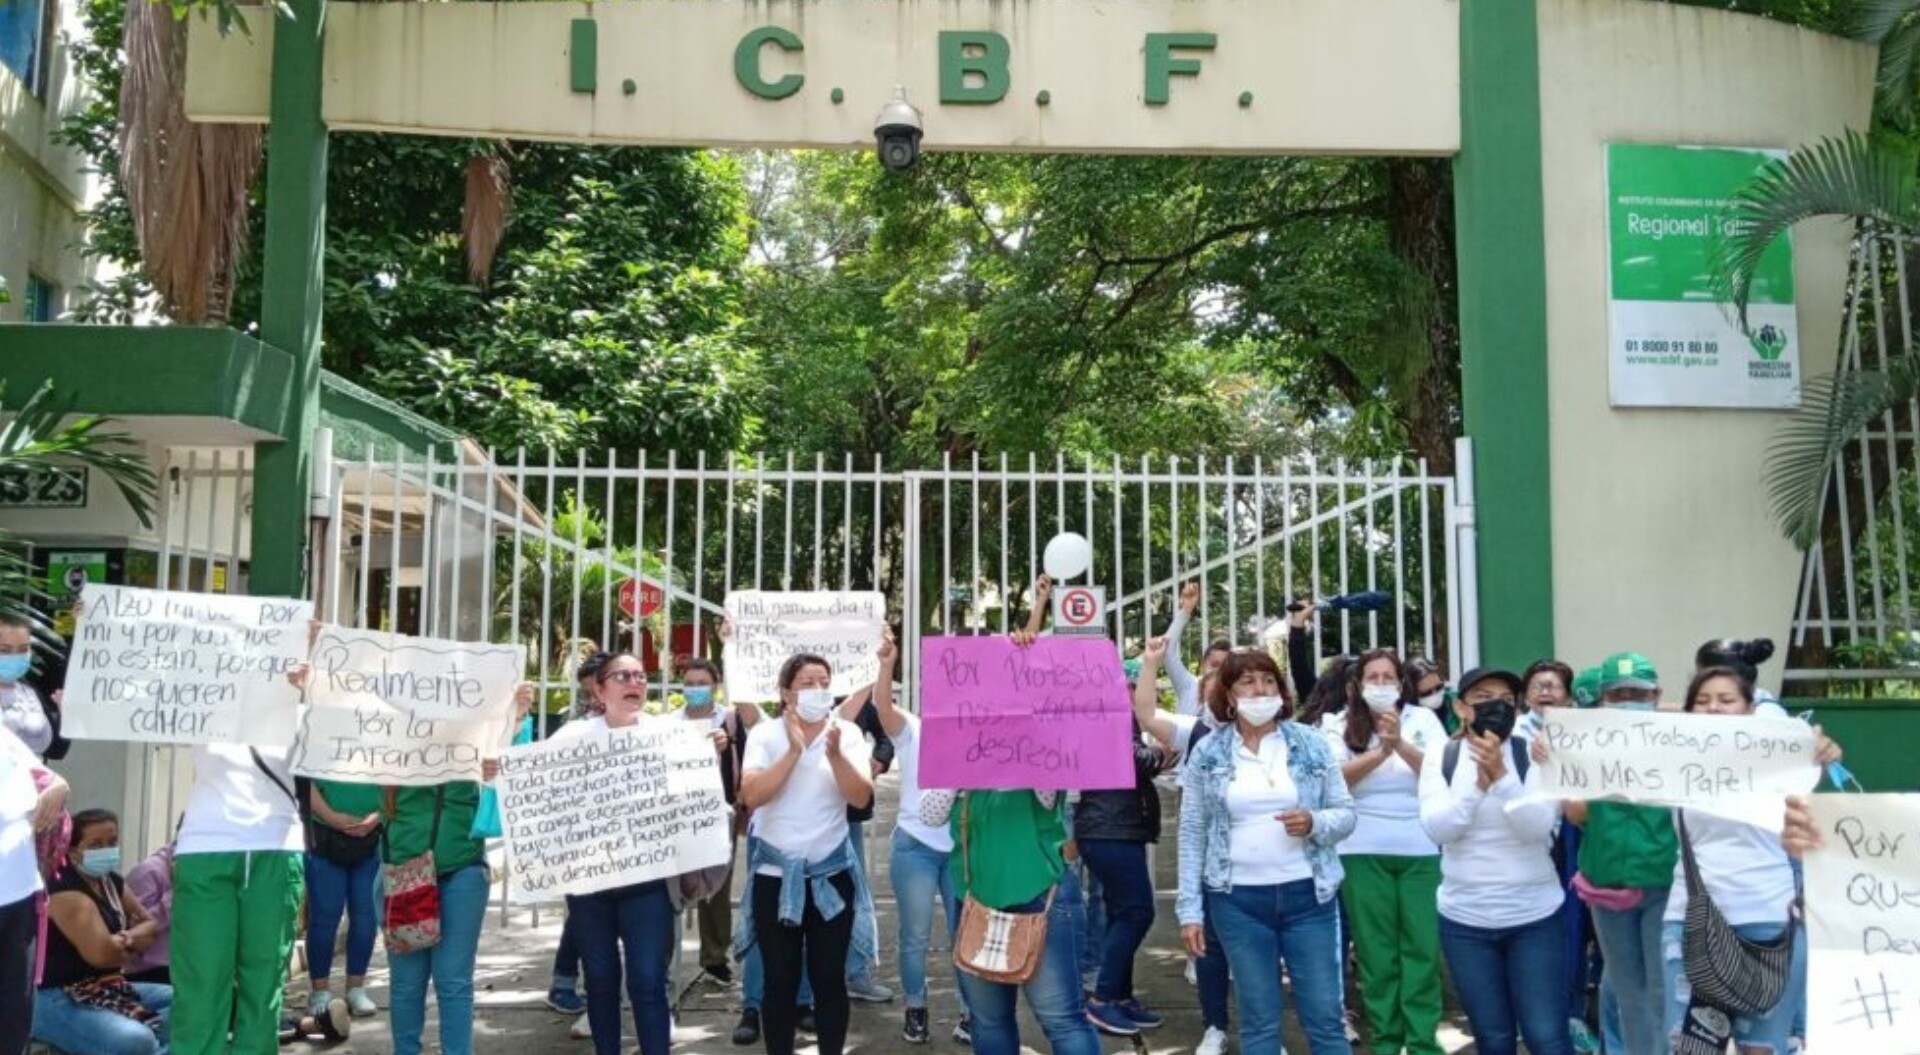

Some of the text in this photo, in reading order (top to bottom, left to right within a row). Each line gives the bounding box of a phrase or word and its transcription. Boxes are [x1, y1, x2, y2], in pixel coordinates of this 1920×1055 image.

[1627, 212, 1708, 240] Regional
[1625, 340, 1638, 352] 01
[1642, 341, 1669, 353] 8000
